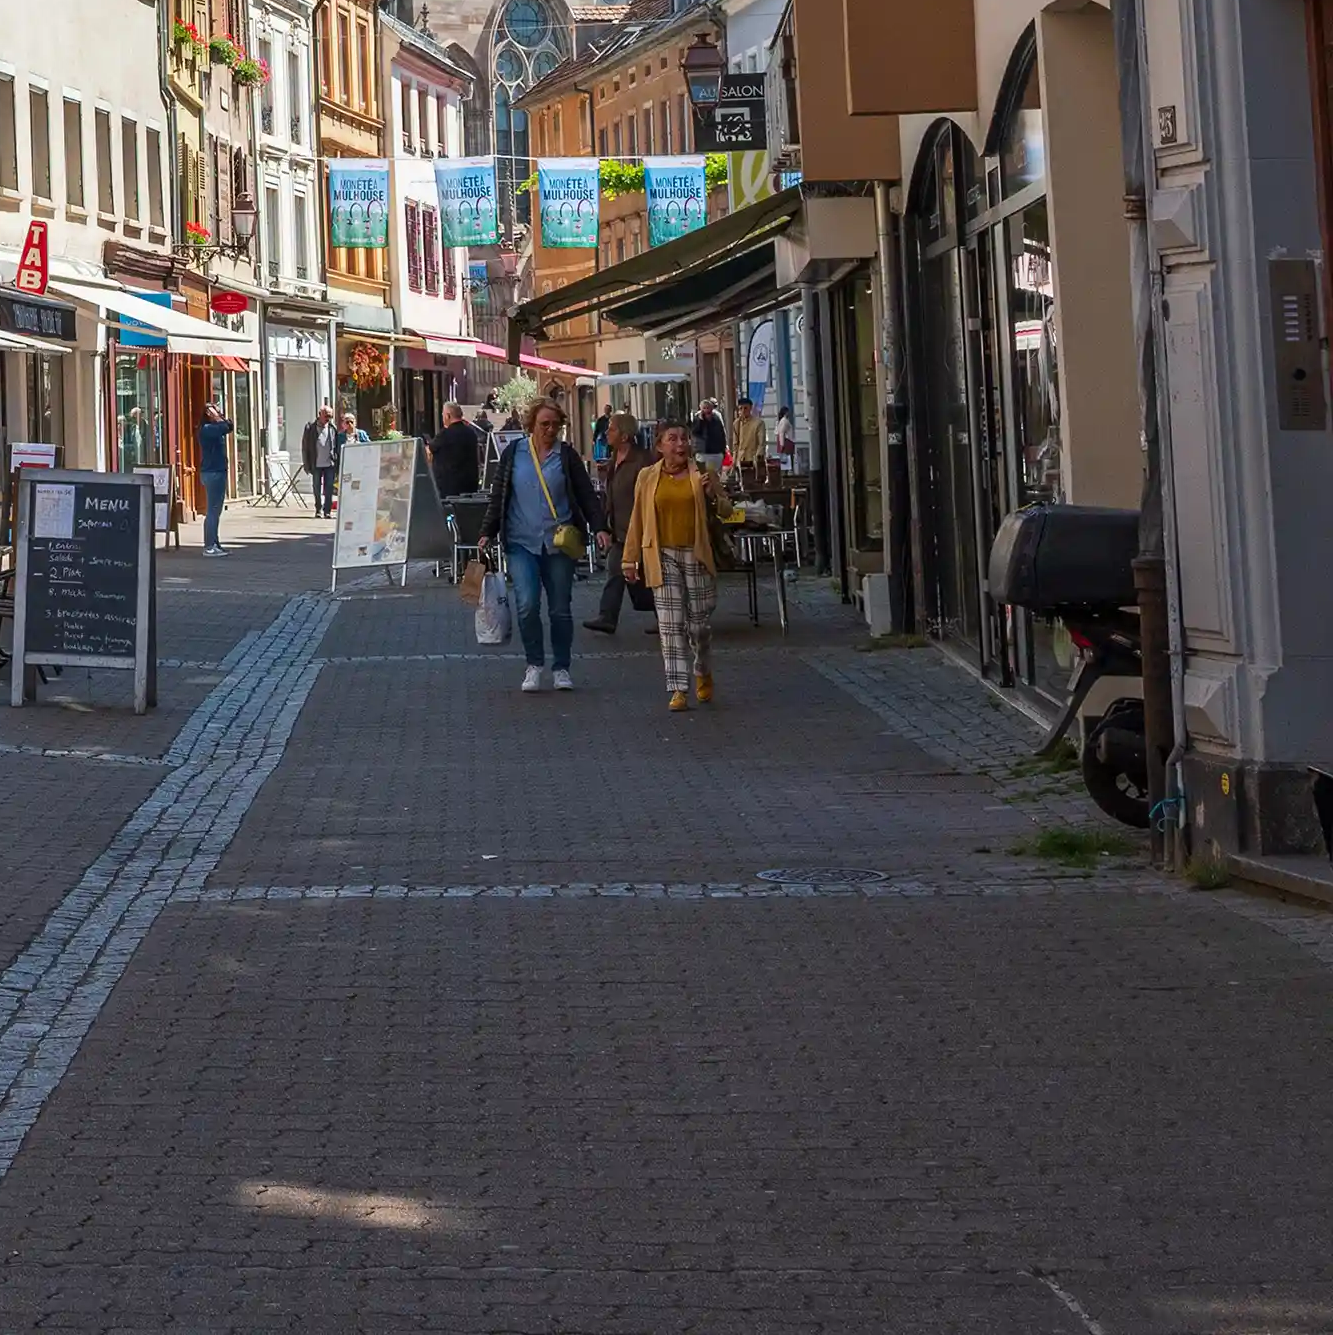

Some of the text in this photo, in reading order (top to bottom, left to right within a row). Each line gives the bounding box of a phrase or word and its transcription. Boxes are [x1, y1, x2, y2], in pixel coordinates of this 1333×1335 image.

[721, 85, 764, 97] SALON
[334, 189, 384, 201] MULHOUSE
[442, 186, 492, 200] MULHOUSE
[543, 189, 595, 200] MULHOUSE
[650, 187, 702, 199] MULHOUSE
[19, 225, 43, 290] TAB
[84, 497, 130, 512] MENU
